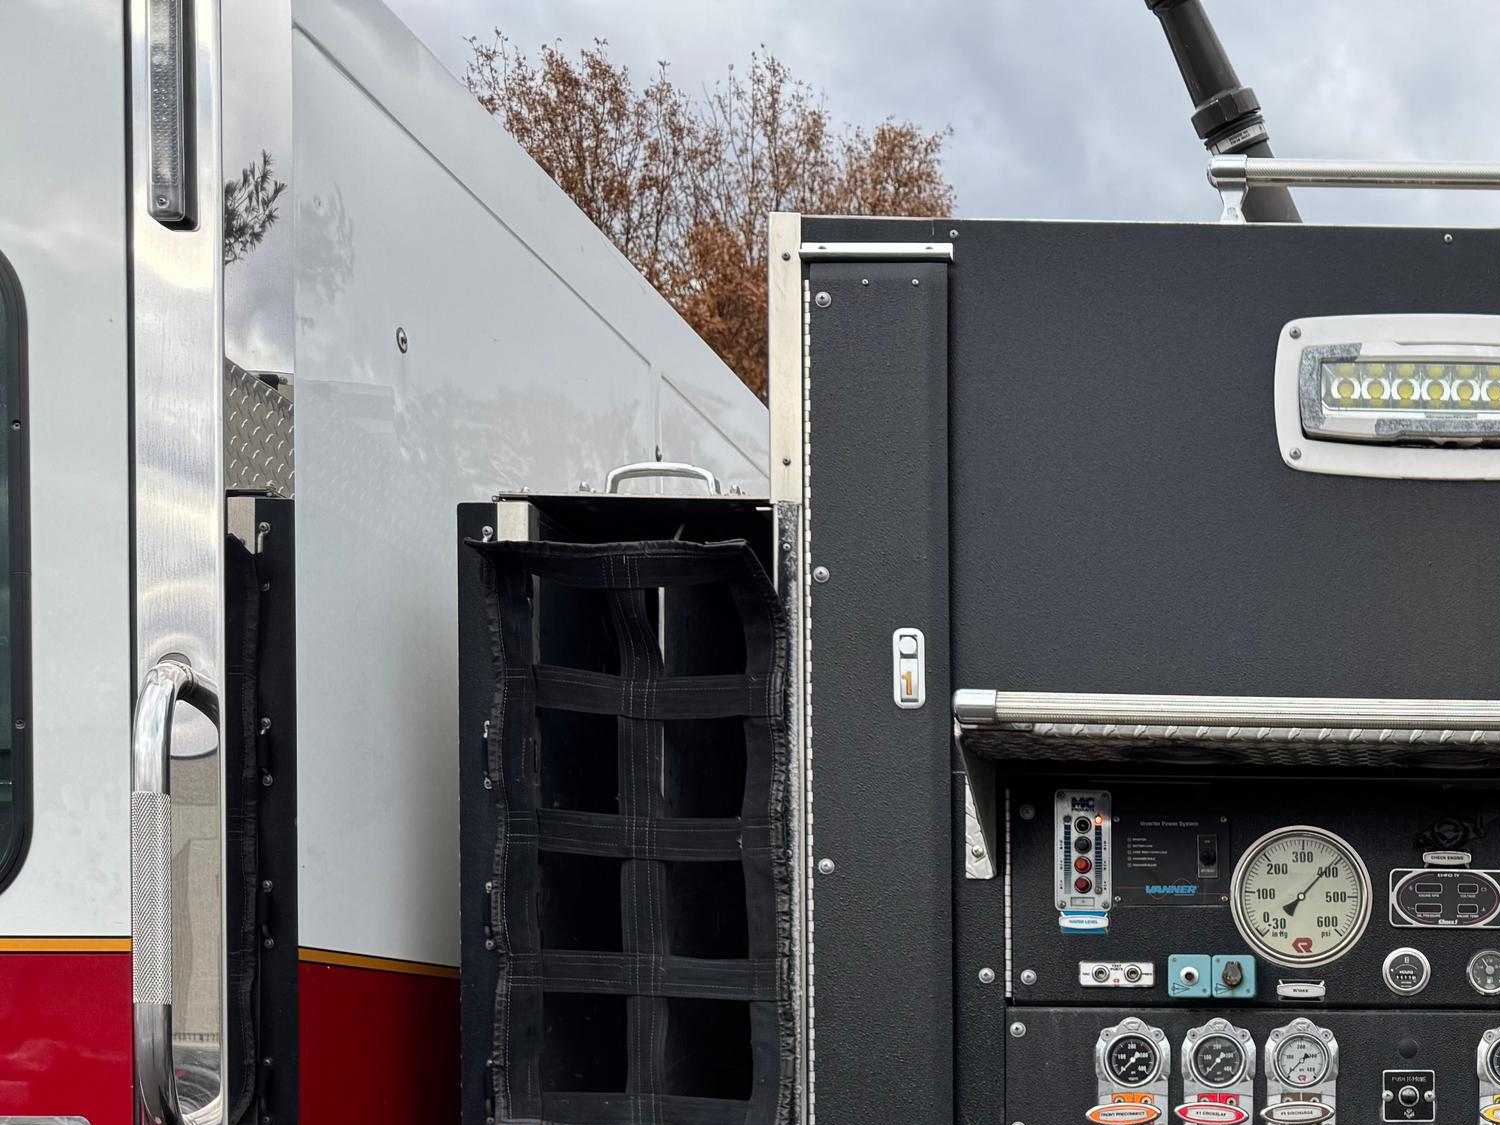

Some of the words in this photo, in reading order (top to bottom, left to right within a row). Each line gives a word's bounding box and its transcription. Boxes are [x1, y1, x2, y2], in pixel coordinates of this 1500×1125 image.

[902, 671, 912, 695] 1
[1292, 852, 1313, 863] 300
[1266, 863, 1288, 875] 200
[1317, 867, 1338, 878] 400
[1146, 885, 1198, 893] VANNER
[1256, 889, 1275, 900] 100
[1326, 892, 1346, 903] 500
[1263, 913, 1269, 923] 0
[1317, 916, 1338, 928] 600
[1268, 918, 1286, 930] -30
